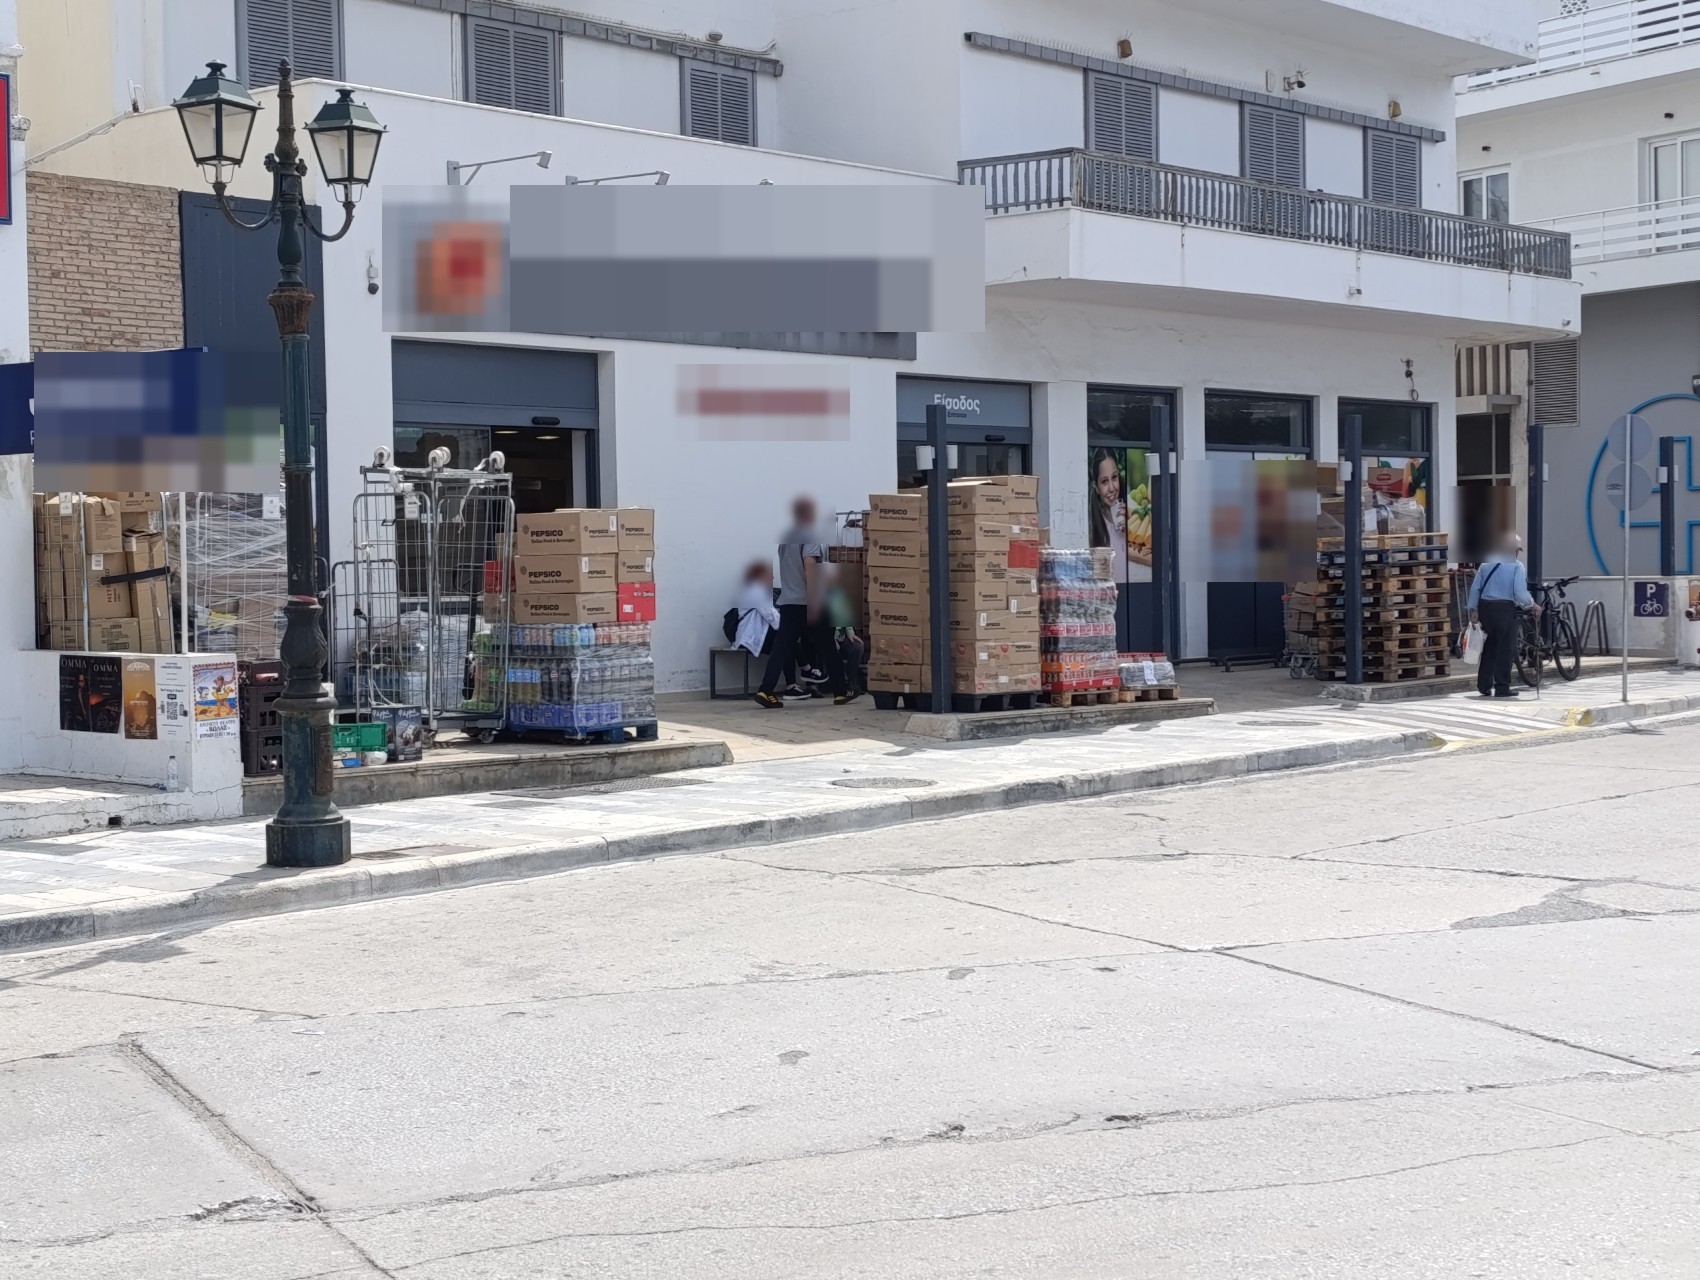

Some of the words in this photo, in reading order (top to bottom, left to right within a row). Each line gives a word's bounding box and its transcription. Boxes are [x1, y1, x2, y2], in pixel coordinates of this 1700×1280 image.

[934, 393, 980, 415] Είσοδος
[531, 529, 563, 537] PEPSICO
[1646, 584, 1656, 598] P
[61, 658, 87, 668] OMMA
[93, 664, 119, 673] OMMA
